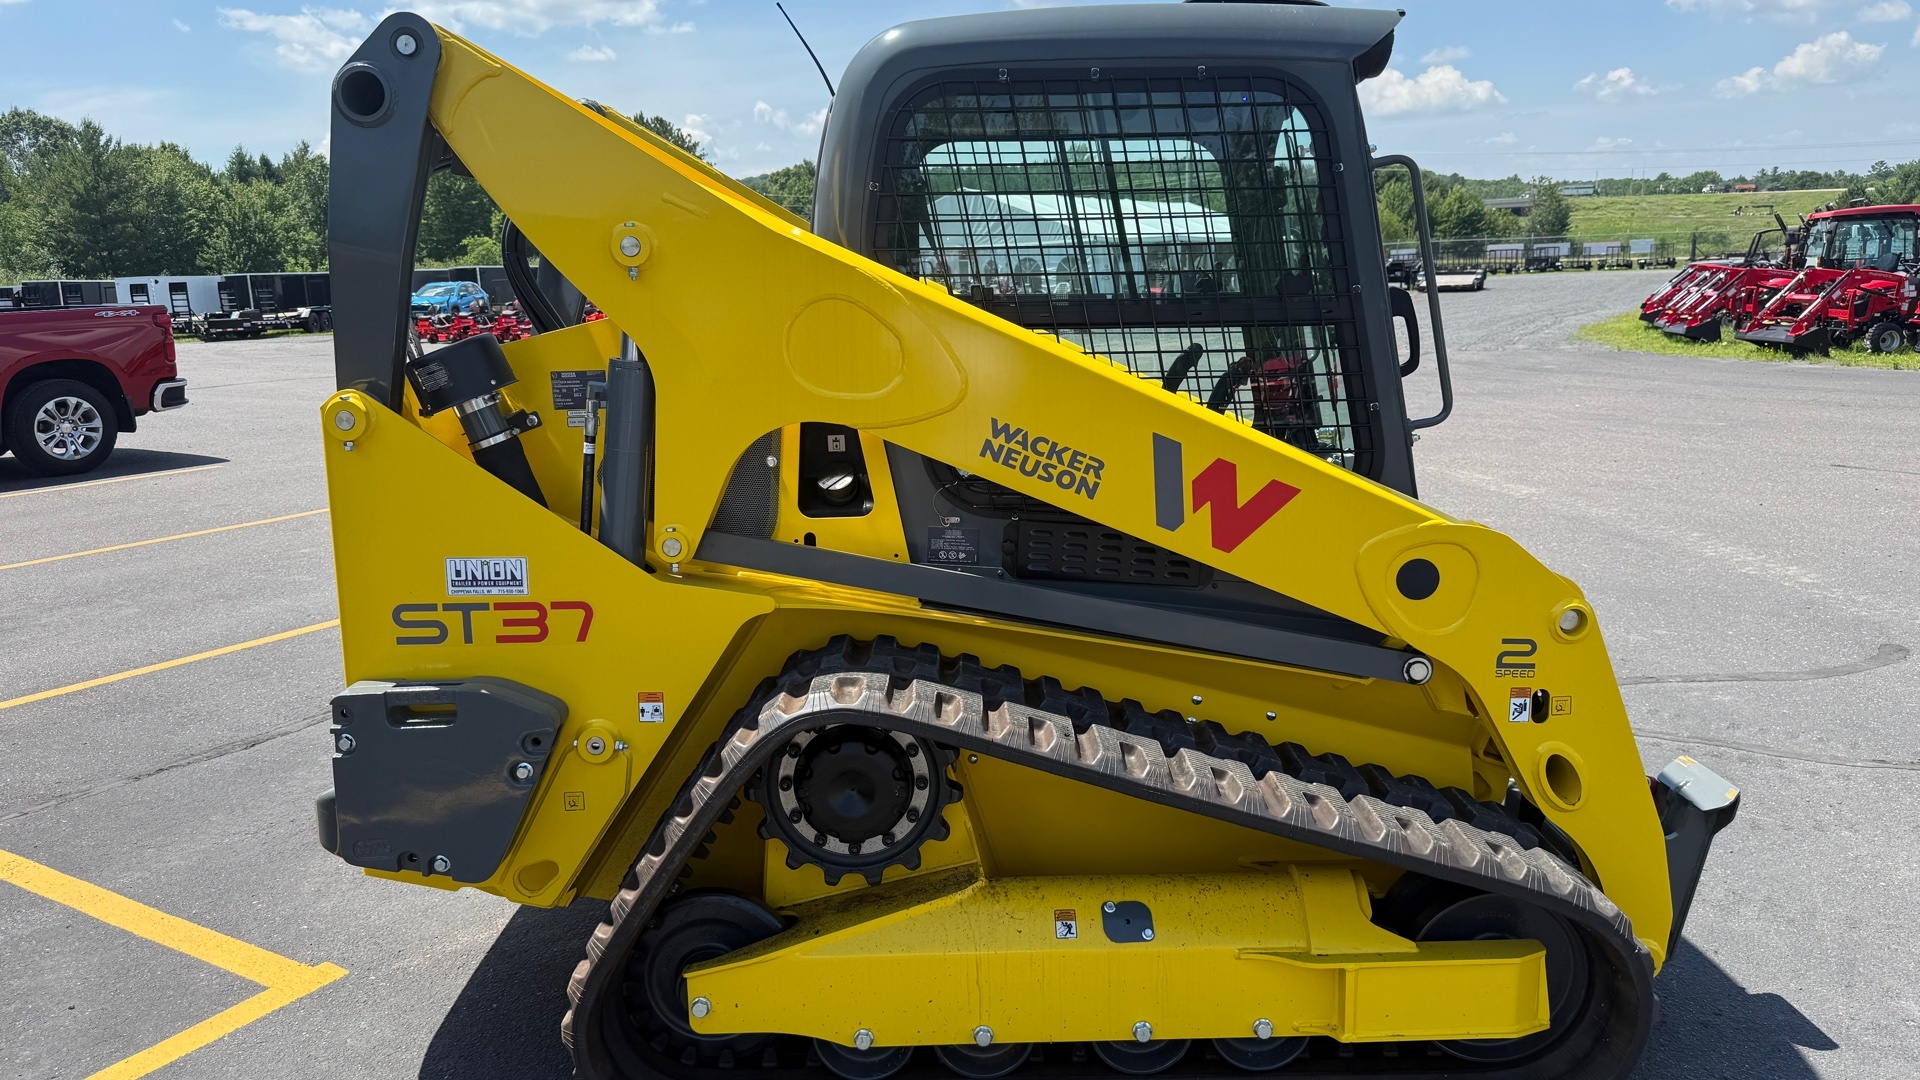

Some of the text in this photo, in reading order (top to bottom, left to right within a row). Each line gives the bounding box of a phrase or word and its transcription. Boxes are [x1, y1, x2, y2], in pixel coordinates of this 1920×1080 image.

[979, 438, 1100, 500] NEUSON
[990, 417, 1105, 480] WACKER
[392, 601, 594, 645] ST37
[1495, 670, 1536, 678] SPEED
[1496, 638, 1538, 669] 2
